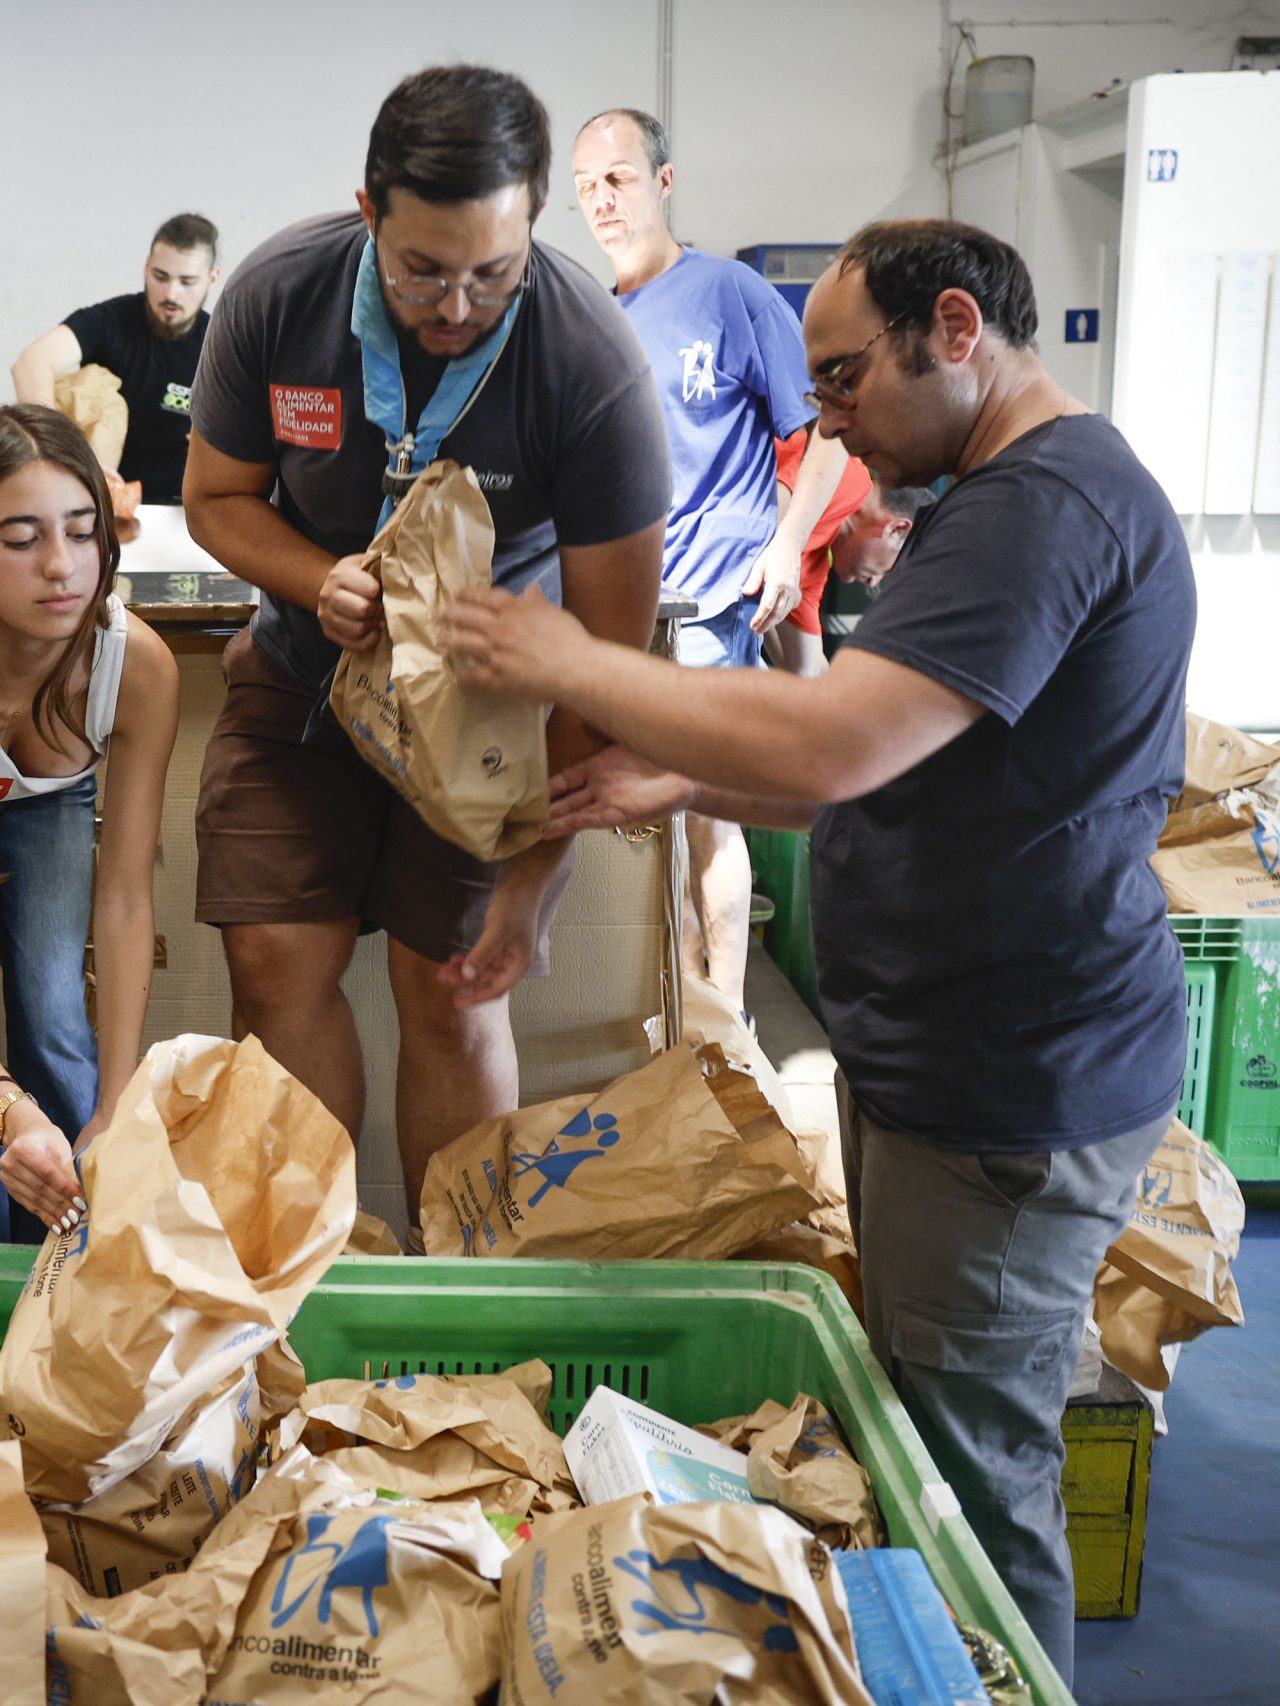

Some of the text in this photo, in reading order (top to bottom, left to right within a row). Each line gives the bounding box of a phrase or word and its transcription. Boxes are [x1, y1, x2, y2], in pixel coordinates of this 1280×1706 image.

[276, 399, 335, 414] ALIMENTAR
[285, 390, 324, 403] BANCO
[278, 416, 334, 434] FIDELIDADE
[580, 1421, 601, 1448] Corn
[582, 1426, 606, 1457] Flakes
[182, 1472, 198, 1496] LEITE
[708, 1472, 752, 1497] Corn
[572, 1572, 594, 1626] contra
[231, 1634, 382, 1669] ncoalimentar
[270, 1660, 324, 1681] contra
[329, 1668, 339, 1681] a
